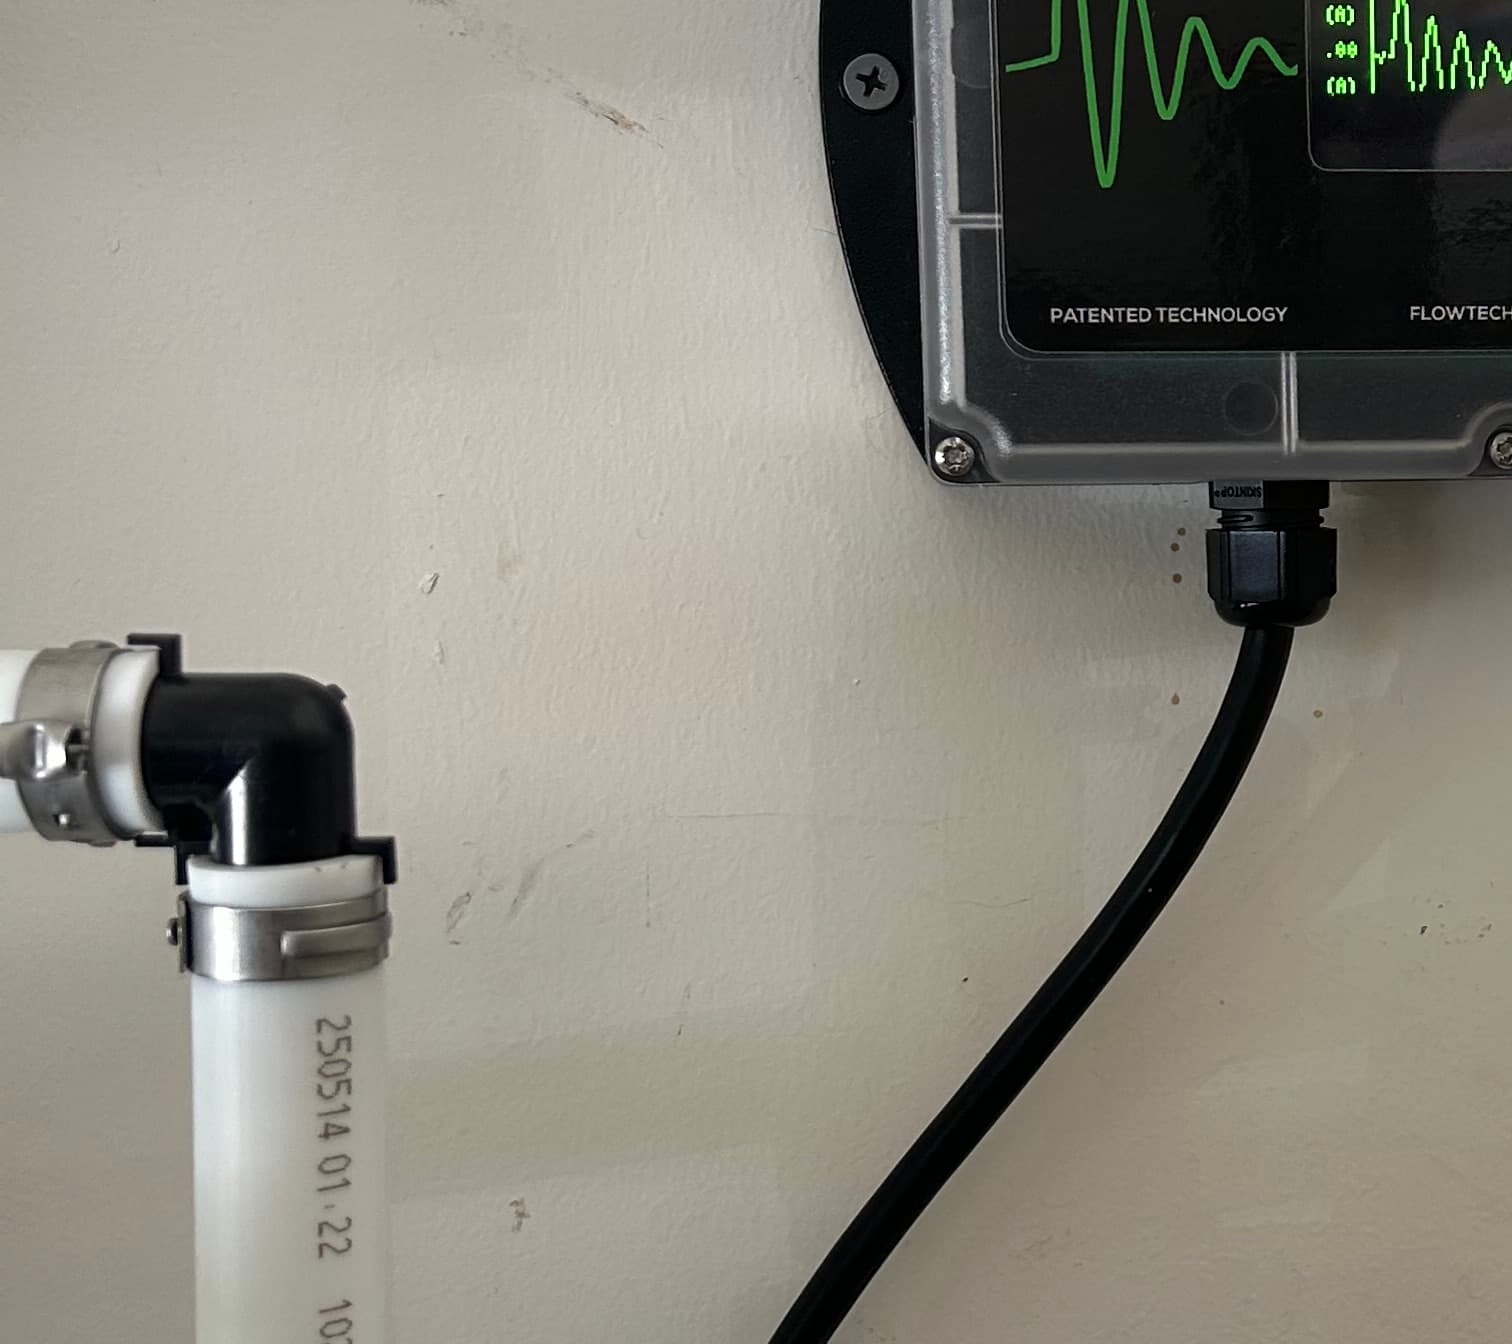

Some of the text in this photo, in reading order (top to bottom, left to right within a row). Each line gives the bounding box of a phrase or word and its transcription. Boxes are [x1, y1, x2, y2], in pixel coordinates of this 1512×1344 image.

[1050, 306, 1289, 323] PATENTED TECHNOLOGY
[314, 1014, 352, 1143] 250514
